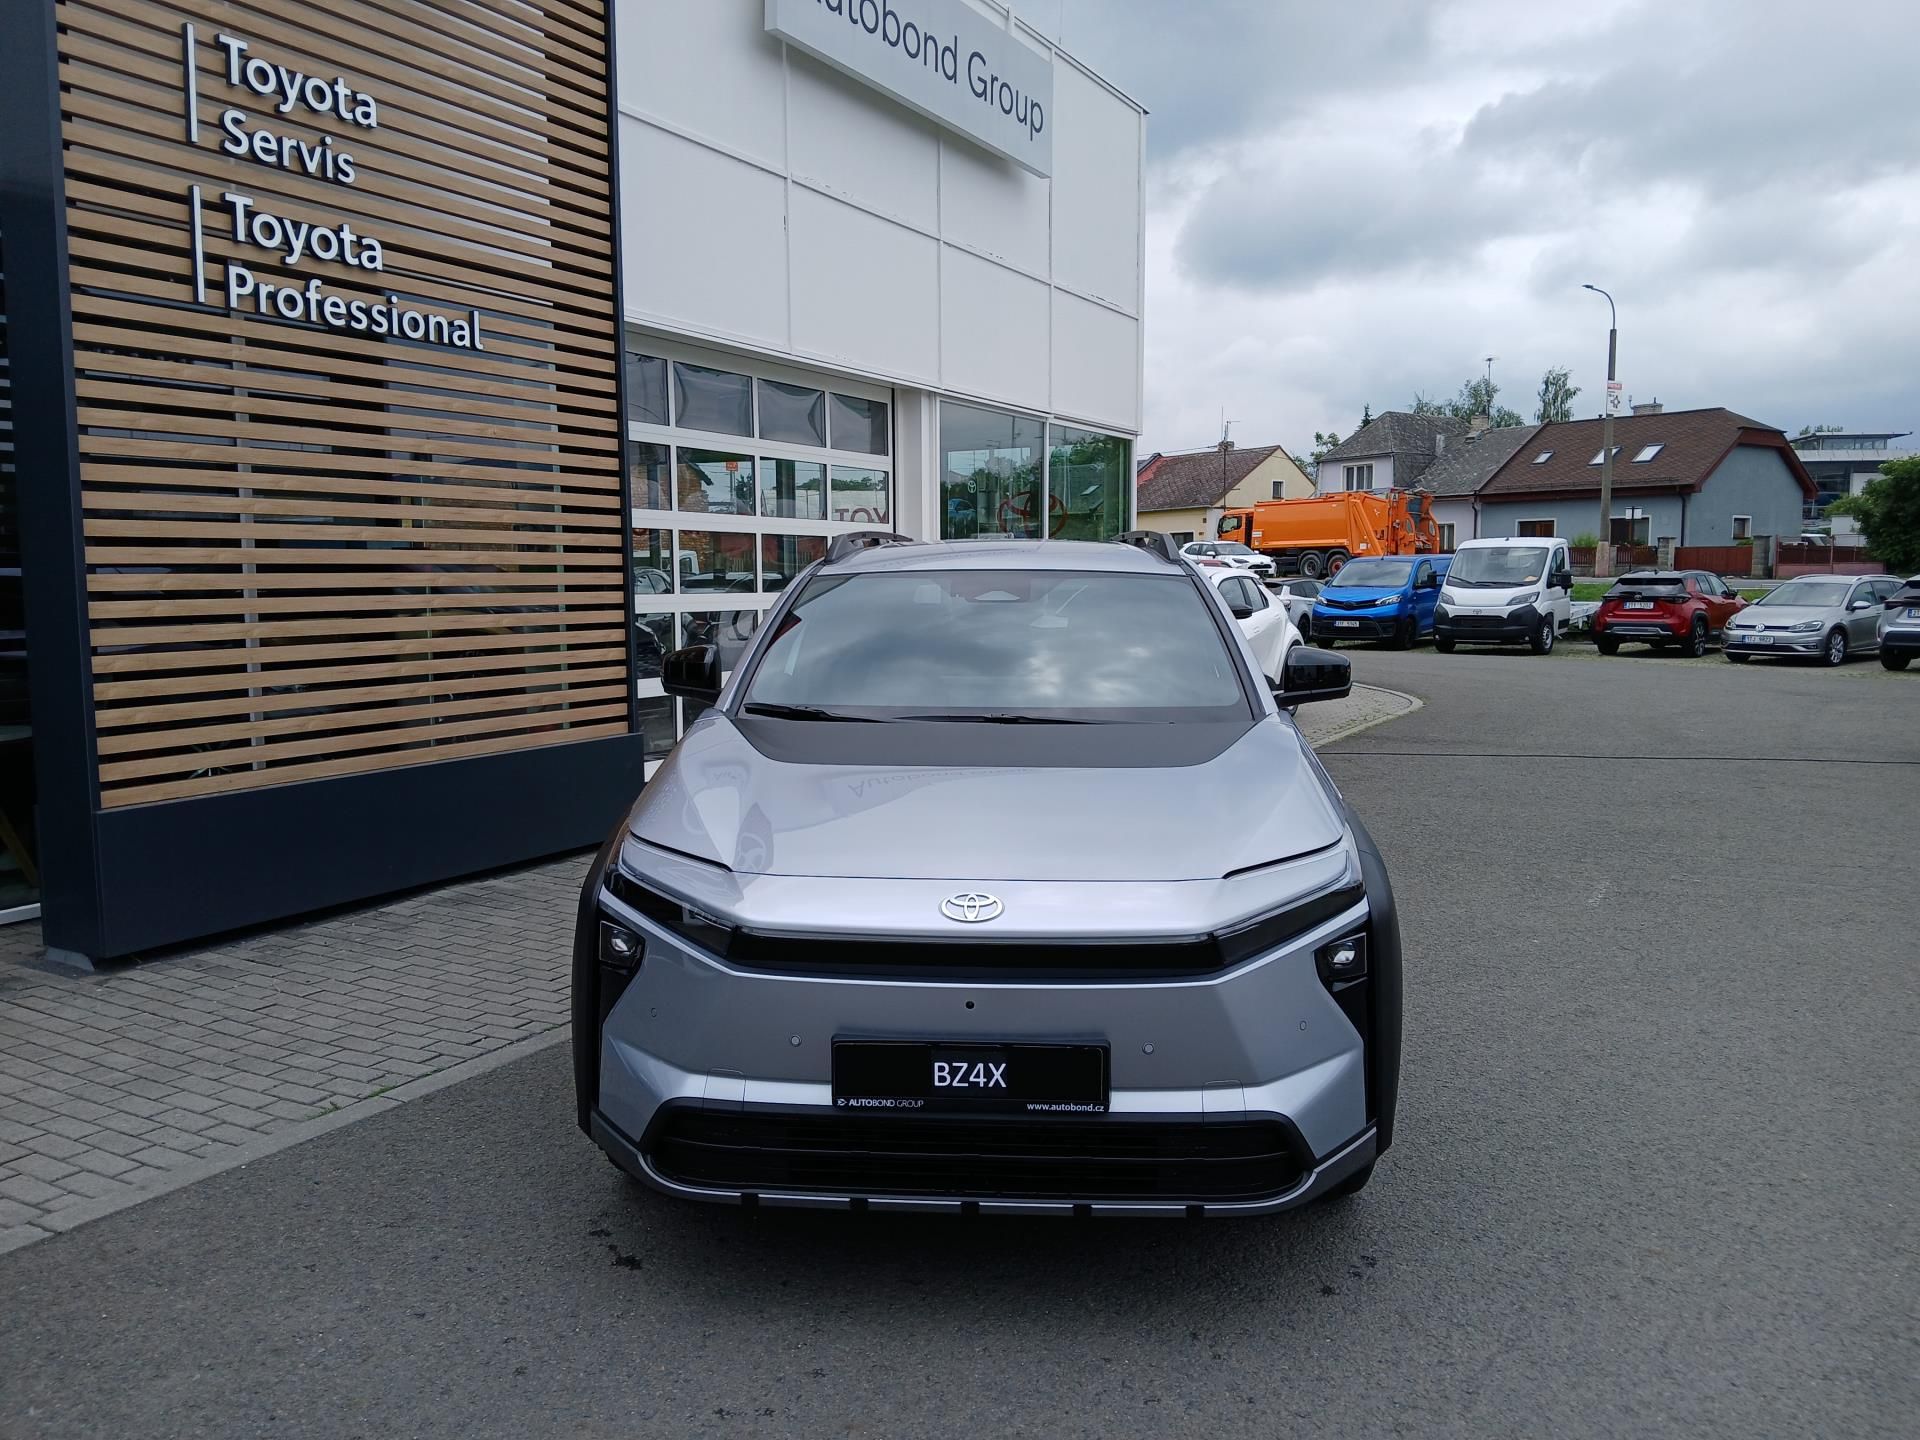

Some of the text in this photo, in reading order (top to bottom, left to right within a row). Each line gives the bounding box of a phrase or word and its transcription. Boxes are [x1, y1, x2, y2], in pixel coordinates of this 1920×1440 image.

[217, 33, 377, 128] Toyota
[816, 0, 1044, 141] tobond Group
[221, 109, 356, 184] Servis
[222, 192, 383, 271] Toyota
[226, 263, 484, 350] Professional
[849, 1098, 924, 1108] AUTOBOND GROUP
[933, 1062, 1007, 1088] BZ4X
[1026, 1102, 1105, 1112] www.autobond.cz
